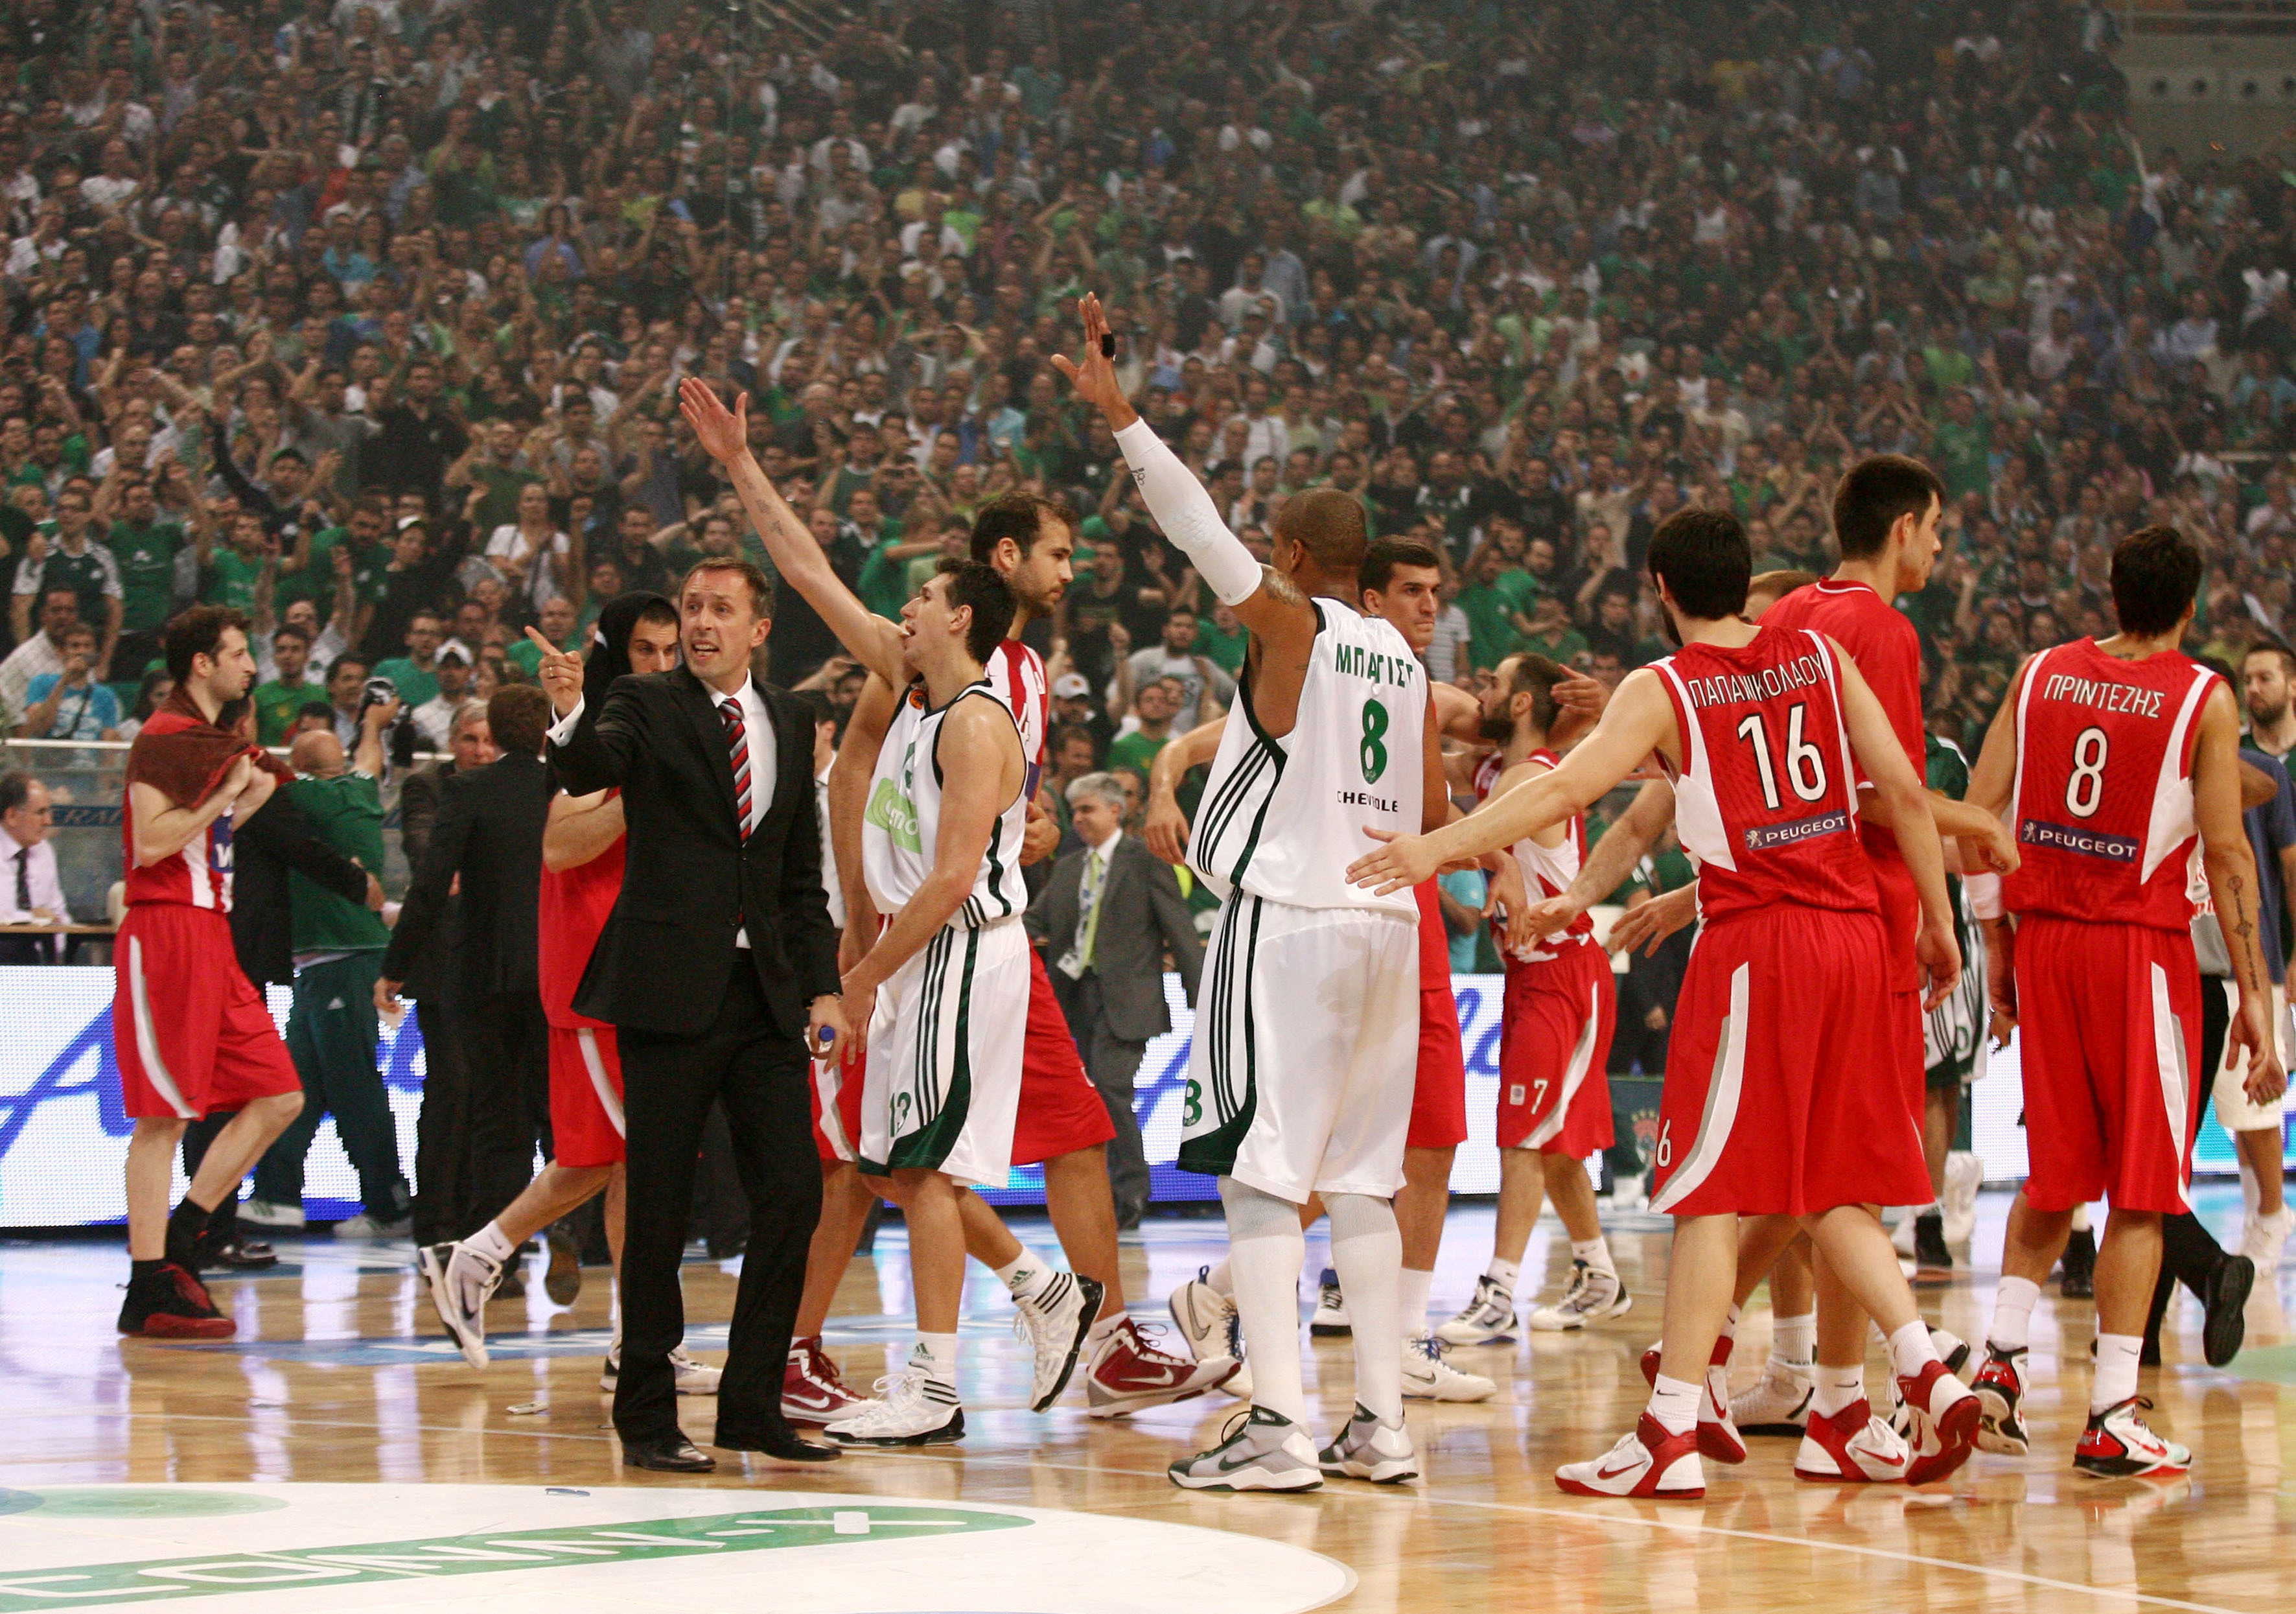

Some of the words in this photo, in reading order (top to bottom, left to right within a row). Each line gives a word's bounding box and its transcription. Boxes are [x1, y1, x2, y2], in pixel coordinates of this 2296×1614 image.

[2043, 673, 2166, 719] ΠΡΙΝΤΕΖΗΣ
[1361, 698, 1389, 784] 8
[1737, 702, 1827, 811] 16
[2065, 725, 2109, 819] 8
[1766, 815, 1846, 843] PEUGEOT
[2039, 829, 2138, 858] PEUGEOT
[1531, 1078, 1549, 1115] 7
